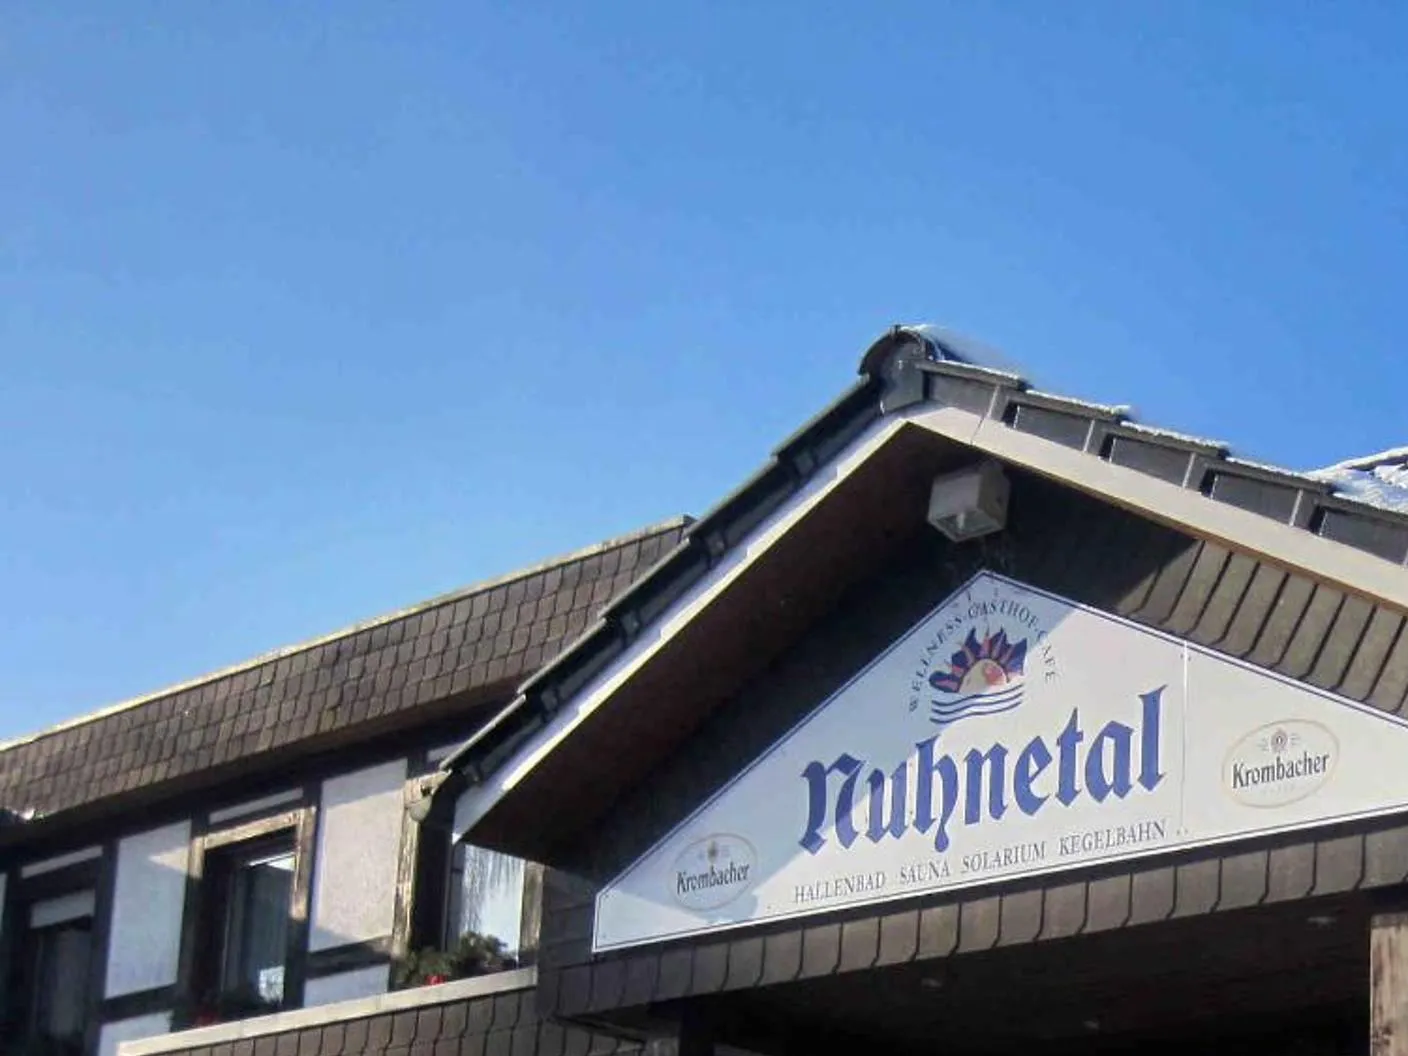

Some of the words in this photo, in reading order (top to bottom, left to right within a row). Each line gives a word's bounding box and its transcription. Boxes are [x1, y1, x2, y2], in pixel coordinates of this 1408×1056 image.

[798, 684, 1169, 855] Nuhnetal
[1231, 750, 1330, 789] Krombacher
[675, 861, 750, 895] Krombacher
[794, 870, 887, 905] HALLENBAD
[900, 854, 951, 885] SAUNA
[960, 839, 1047, 878] SOLARIUM
[1058, 818, 1167, 857] KEGELBAHN
